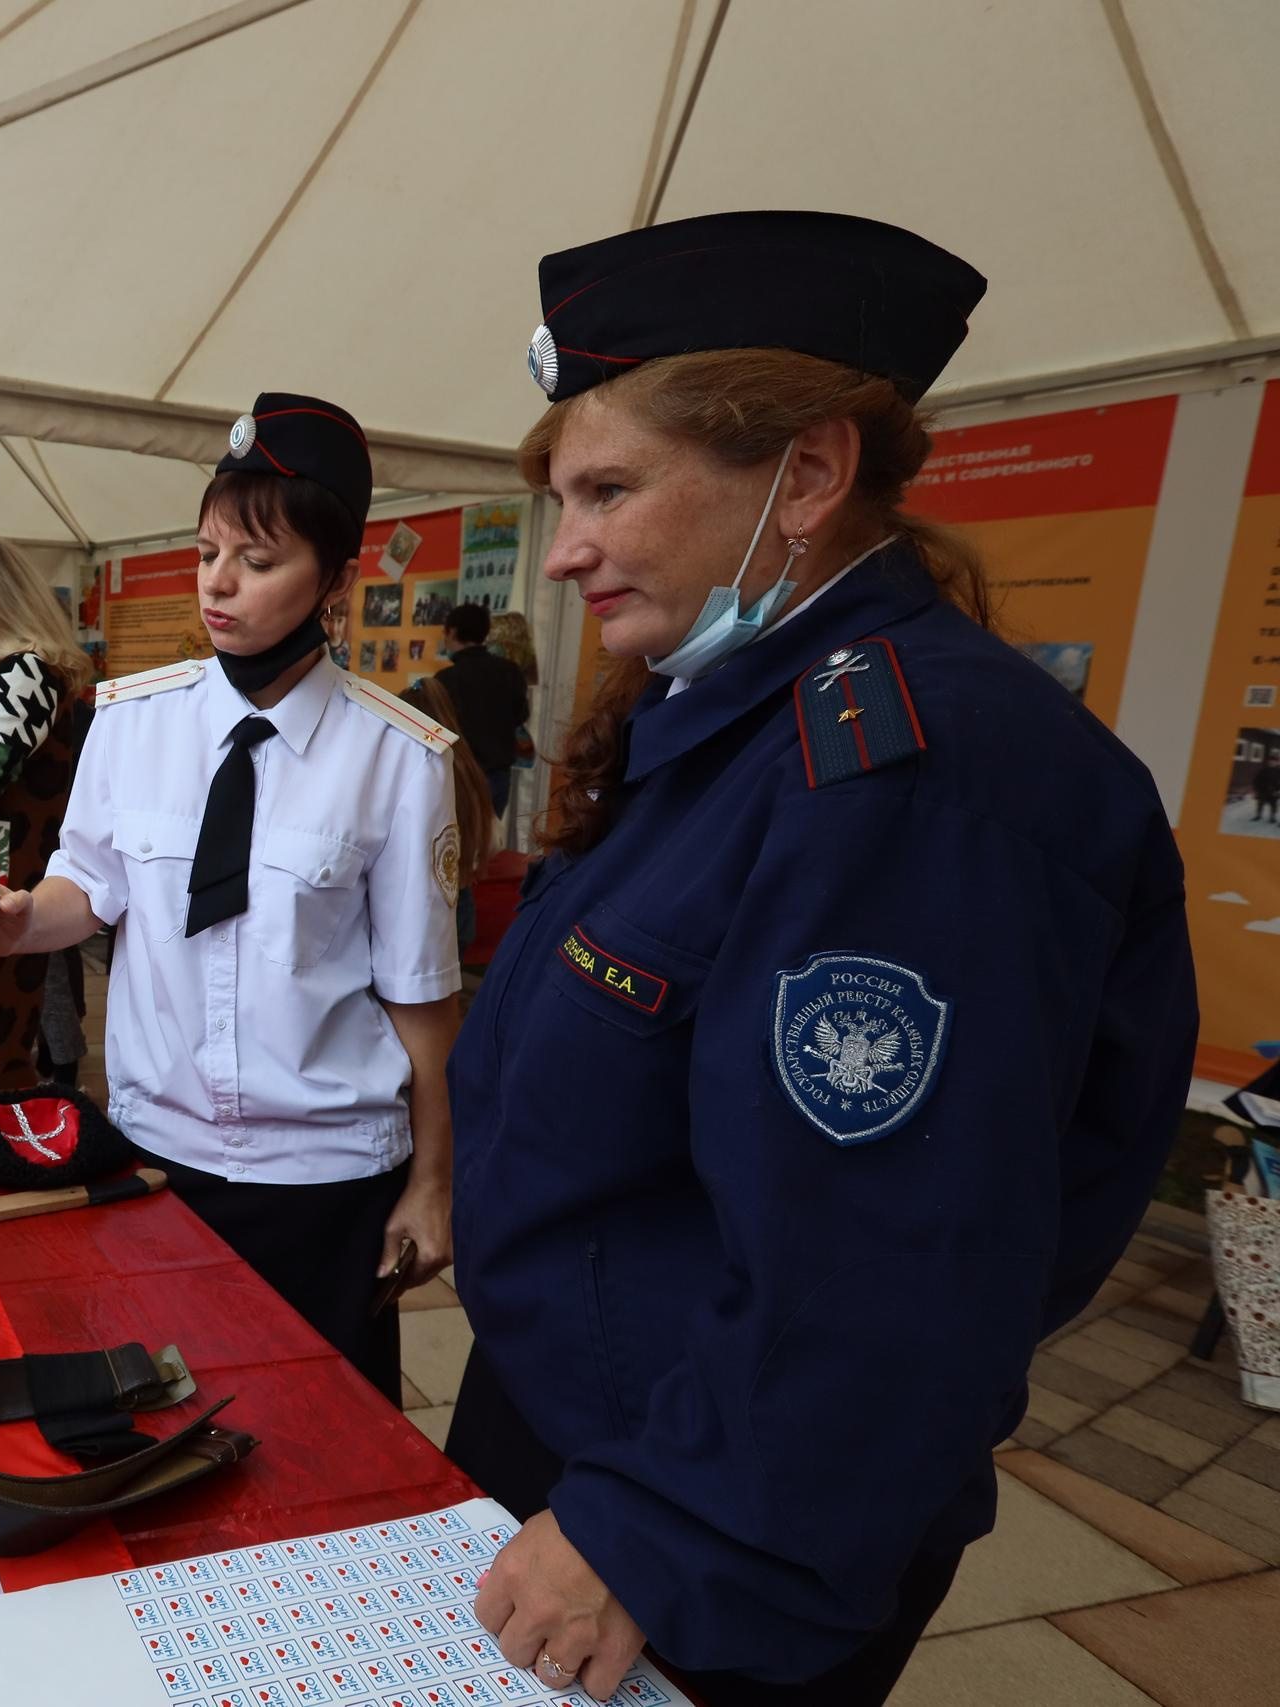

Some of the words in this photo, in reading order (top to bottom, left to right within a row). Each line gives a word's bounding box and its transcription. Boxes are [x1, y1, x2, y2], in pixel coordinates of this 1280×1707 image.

[959, 454, 1093, 481] СОВРЕМЕННОГО
[605, 967, 636, 994] Е.А.
[829, 972, 904, 997] РОССИЯ
[835, 990, 892, 1010] РЕЕСТР
[417, 1521, 434, 1537] НКО
[446, 1514, 464, 1530] НКО
[357, 1533, 374, 1549] НКО
[387, 1527, 404, 1543] НКО
[294, 1543, 311, 1560] НКО
[325, 1538, 342, 1555] НКО
[438, 1546, 457, 1563] НКО
[469, 1539, 487, 1556] НКО
[230, 1556, 246, 1573] НКО
[263, 1549, 279, 1567] НКО
[377, 1558, 395, 1576] НКО
[408, 1552, 427, 1570] НКО
[163, 1568, 179, 1586] НКО
[197, 1561, 212, 1580] НКО
[313, 1570, 331, 1588] НКО
[346, 1565, 363, 1583] НКО
[129, 1575, 144, 1593] НКО
[247, 1583, 264, 1602] НКО
[280, 1576, 297, 1595] НКО
[430, 1579, 449, 1598] НКО
[213, 1591, 230, 1610] НКО
[366, 1592, 385, 1612] НКО
[398, 1586, 417, 1605] НКО
[144, 1605, 159, 1624] НКО
[179, 1598, 195, 1617] НКО
[300, 1606, 318, 1626] НКО
[333, 1599, 351, 1618] НКО
[266, 1613, 283, 1633] НКО
[421, 1615, 441, 1635] НКО
[454, 1608, 474, 1628] НКО
[195, 1628, 212, 1649] НКО
[231, 1620, 248, 1641] НКО
[355, 1629, 374, 1650] НКО
[389, 1623, 408, 1643] НКО
[159, 1636, 175, 1657] НКО
[285, 1644, 304, 1666] НКО
[320, 1636, 339, 1657] НКО
[479, 1639, 500, 1660] НКО
[249, 1652, 267, 1674] НКО
[412, 1654, 433, 1676] НКО
[446, 1646, 467, 1668] НКО
[175, 1668, 192, 1691] НКО
[212, 1660, 230, 1682] НКО
[342, 1669, 361, 1692] НКО
[377, 1662, 397, 1684] НКО
[306, 1678, 325, 1701] НКО
[472, 1680, 494, 1703] НКО
[507, 1672, 529, 1694] НКО
[636, 1680, 662, 1702] НКО
